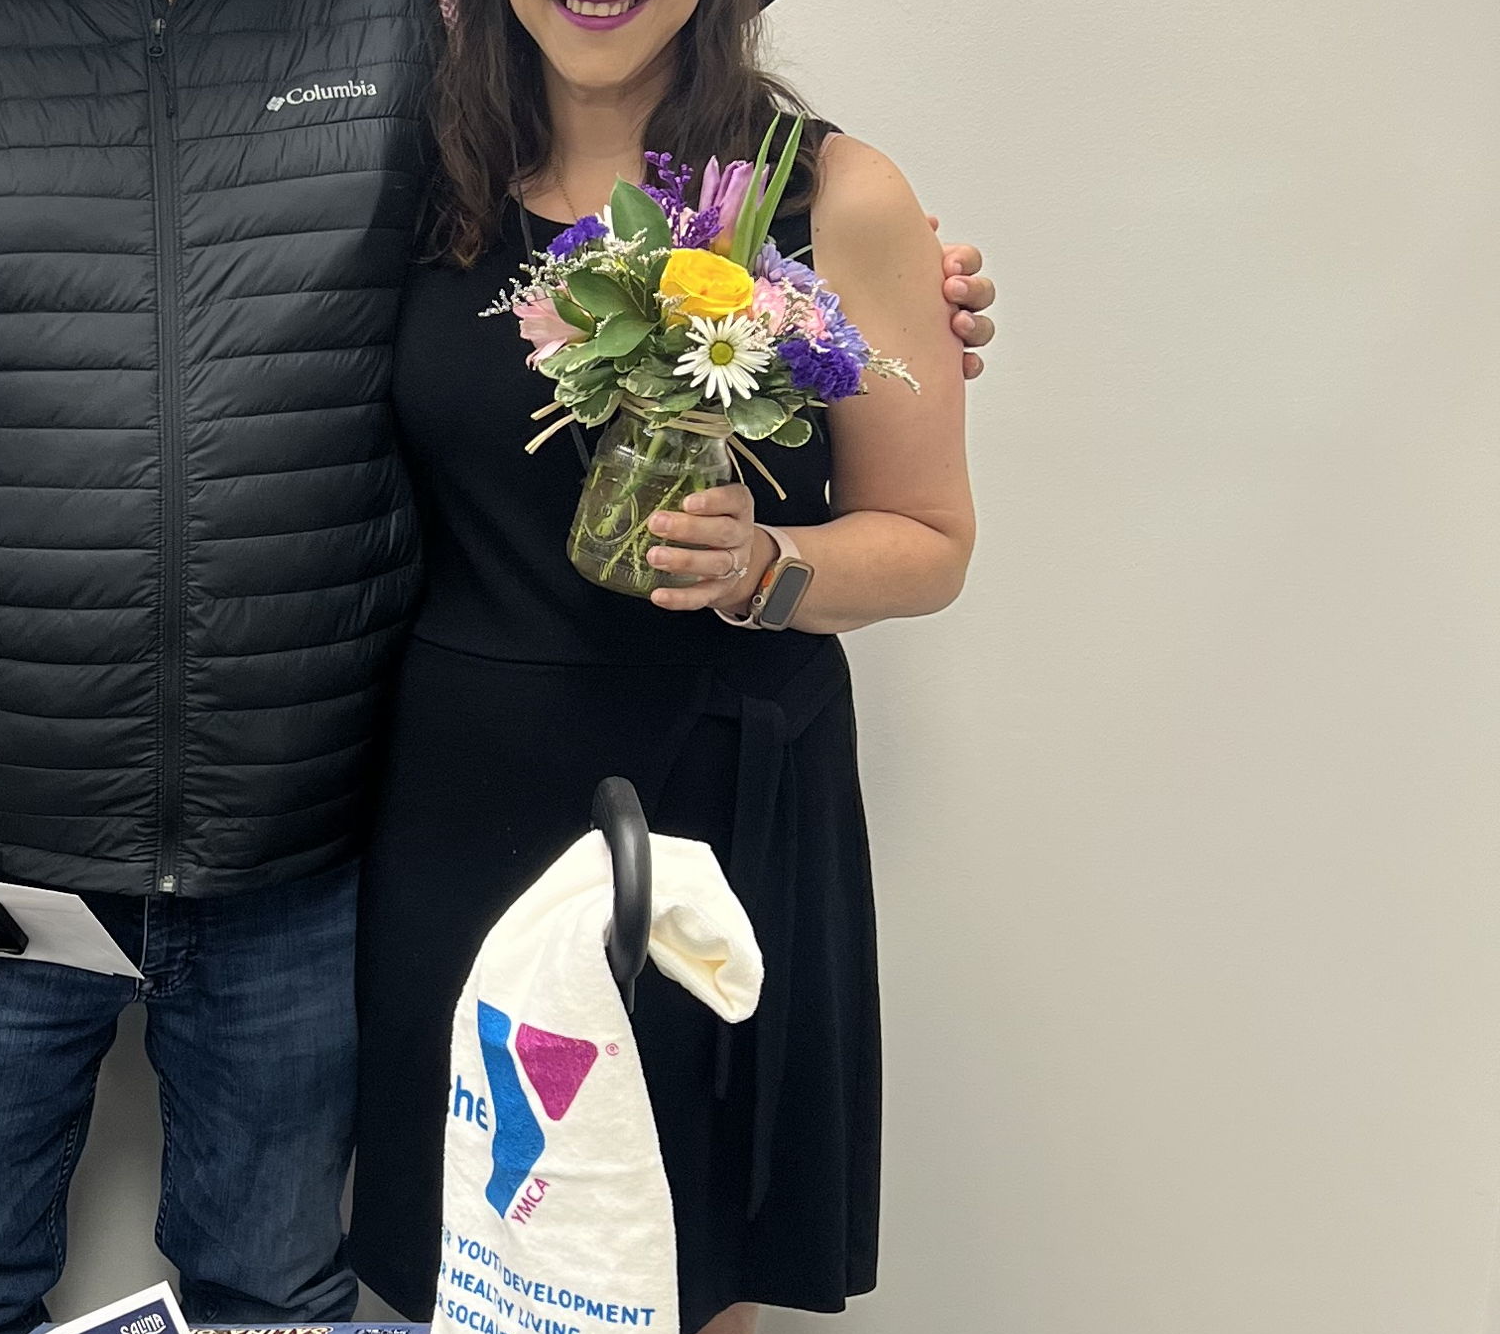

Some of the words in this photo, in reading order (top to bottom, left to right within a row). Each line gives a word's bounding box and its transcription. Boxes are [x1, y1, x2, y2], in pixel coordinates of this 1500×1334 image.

[286, 80, 376, 104] Columbia
[449, 1075, 488, 1131] he
[512, 1178, 550, 1224] YMCA
[504, 1266, 655, 1326] DEVELOPMENT
